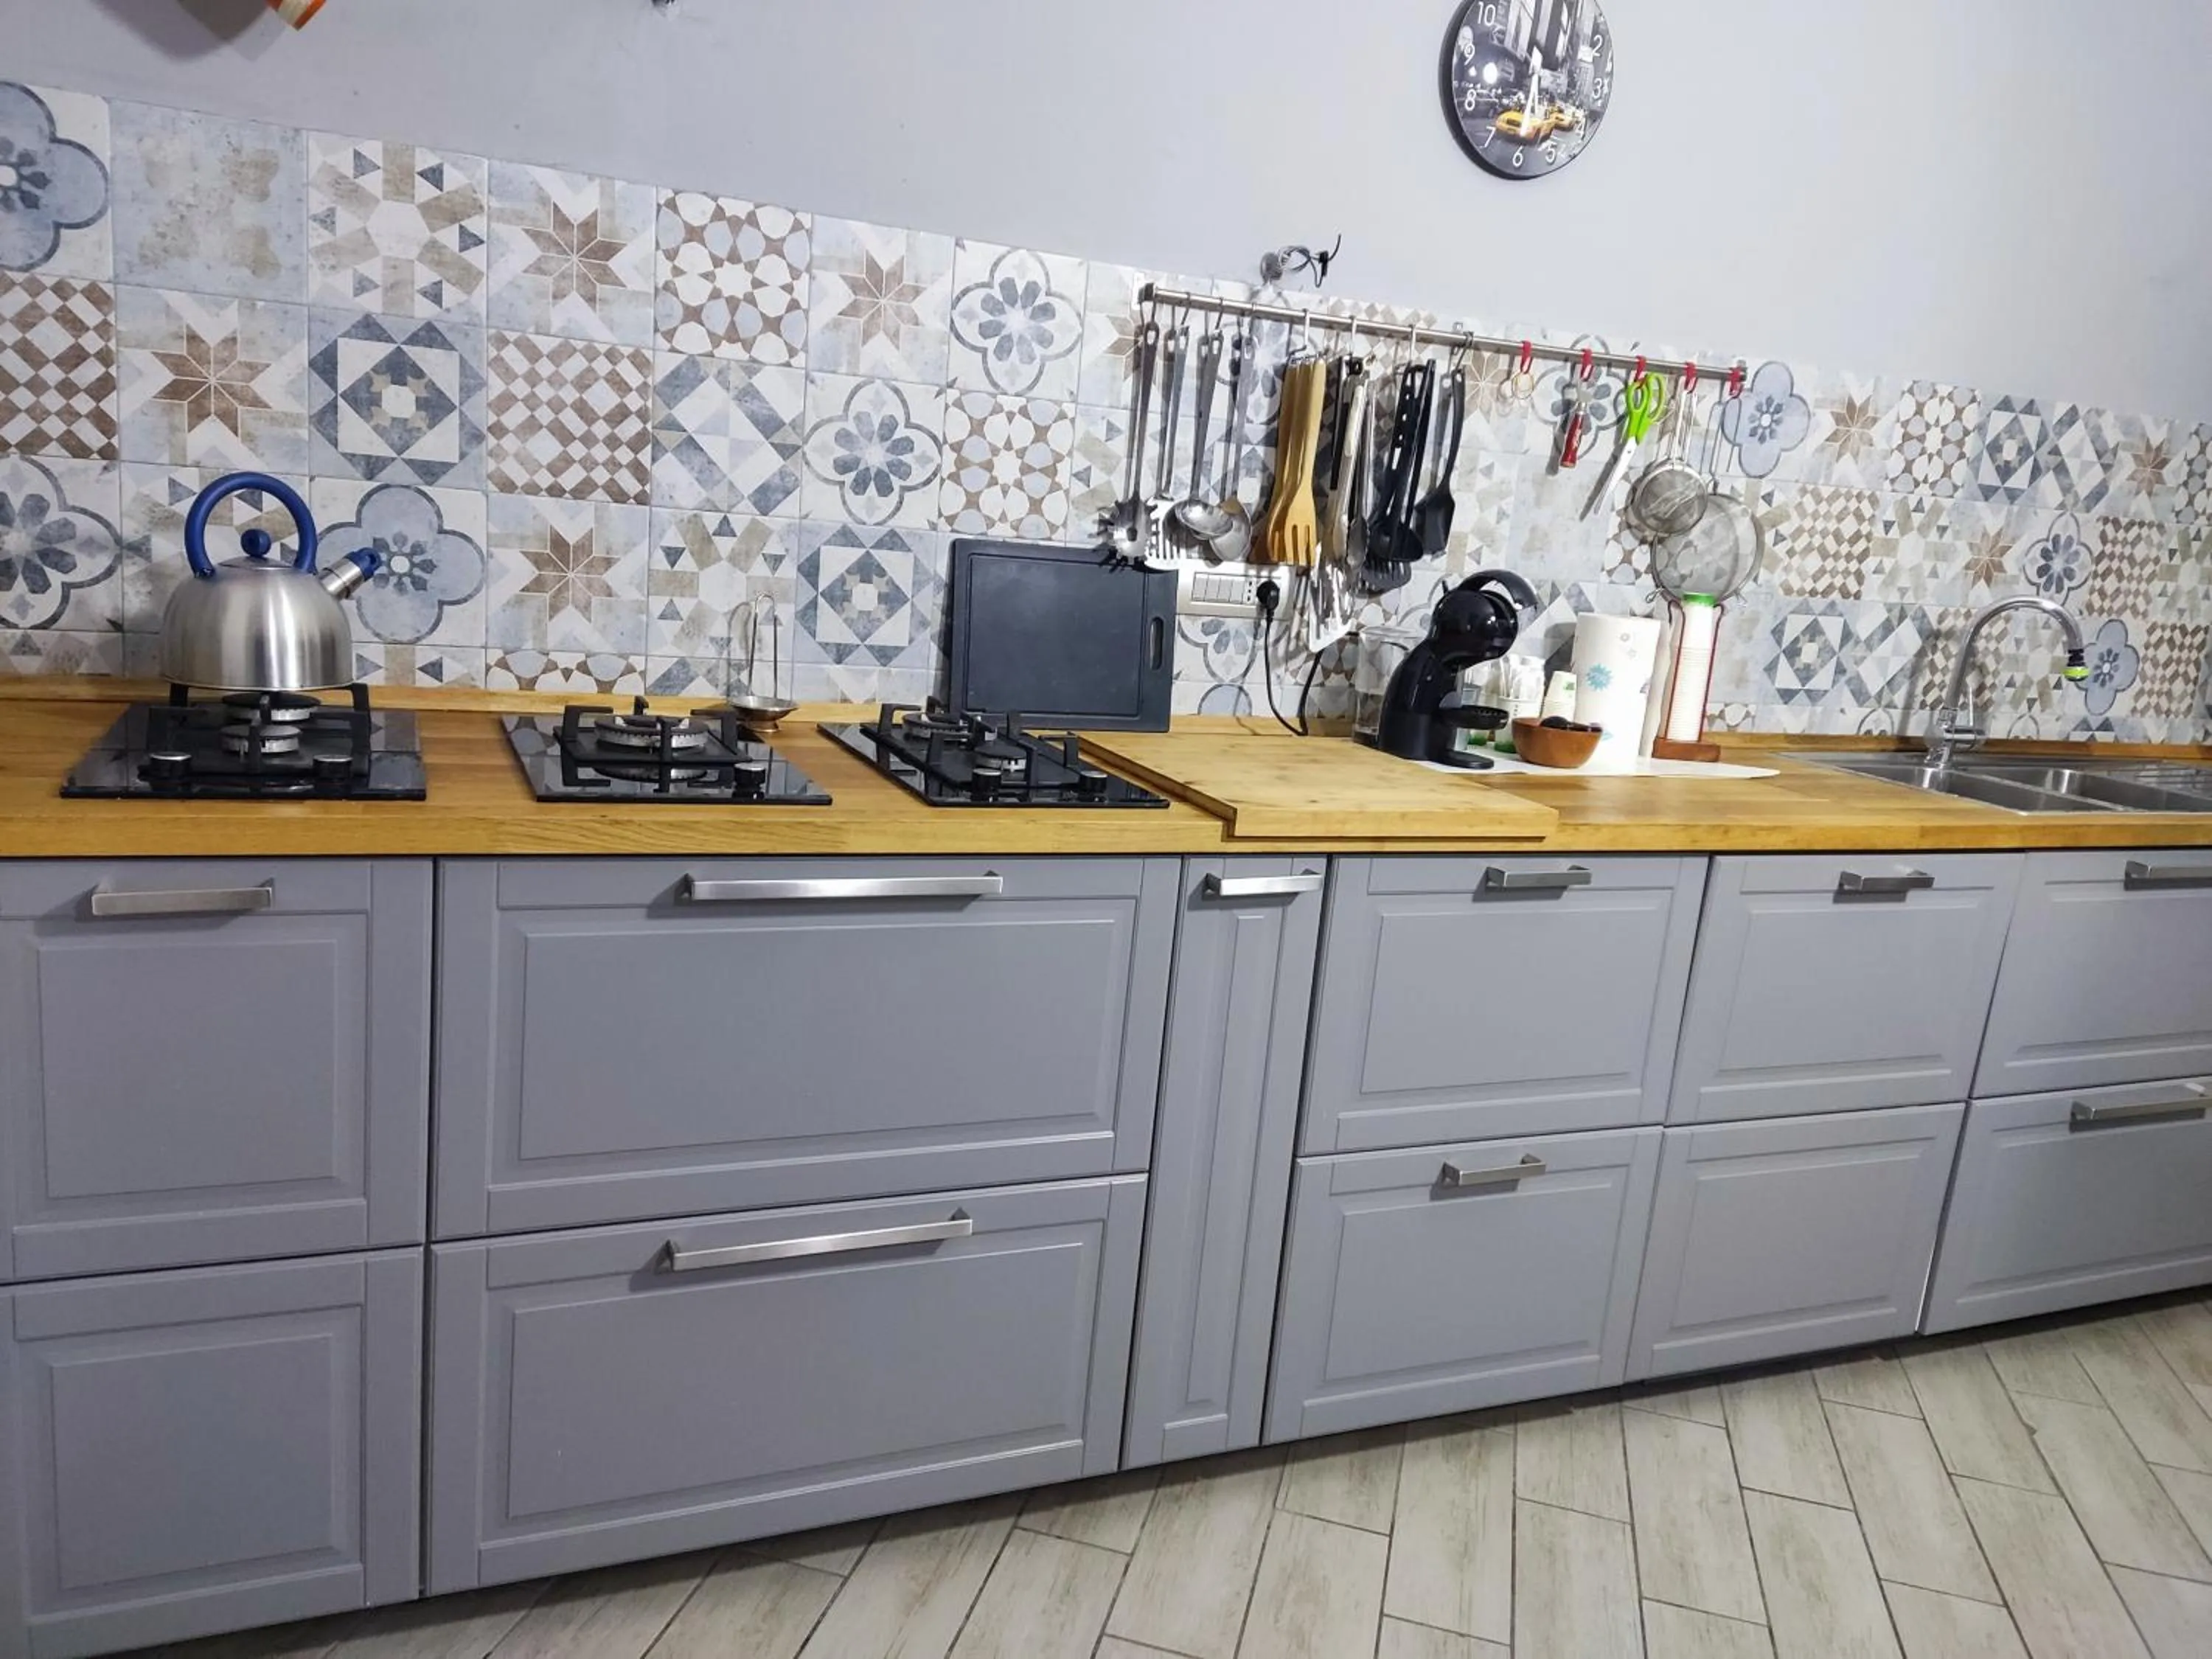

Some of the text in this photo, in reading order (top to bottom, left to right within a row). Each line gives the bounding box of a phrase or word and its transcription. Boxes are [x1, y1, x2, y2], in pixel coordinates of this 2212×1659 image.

[1477, 1, 1496, 27] 10
[1464, 44, 1475, 66] 9
[1592, 35, 1602, 57] 2
[1464, 88, 1476, 111] 8
[1593, 77, 1603, 100] 3
[1485, 126, 1496, 147] 7
[1512, 145, 1523, 167] 6
[1545, 139, 1557, 162] 5
